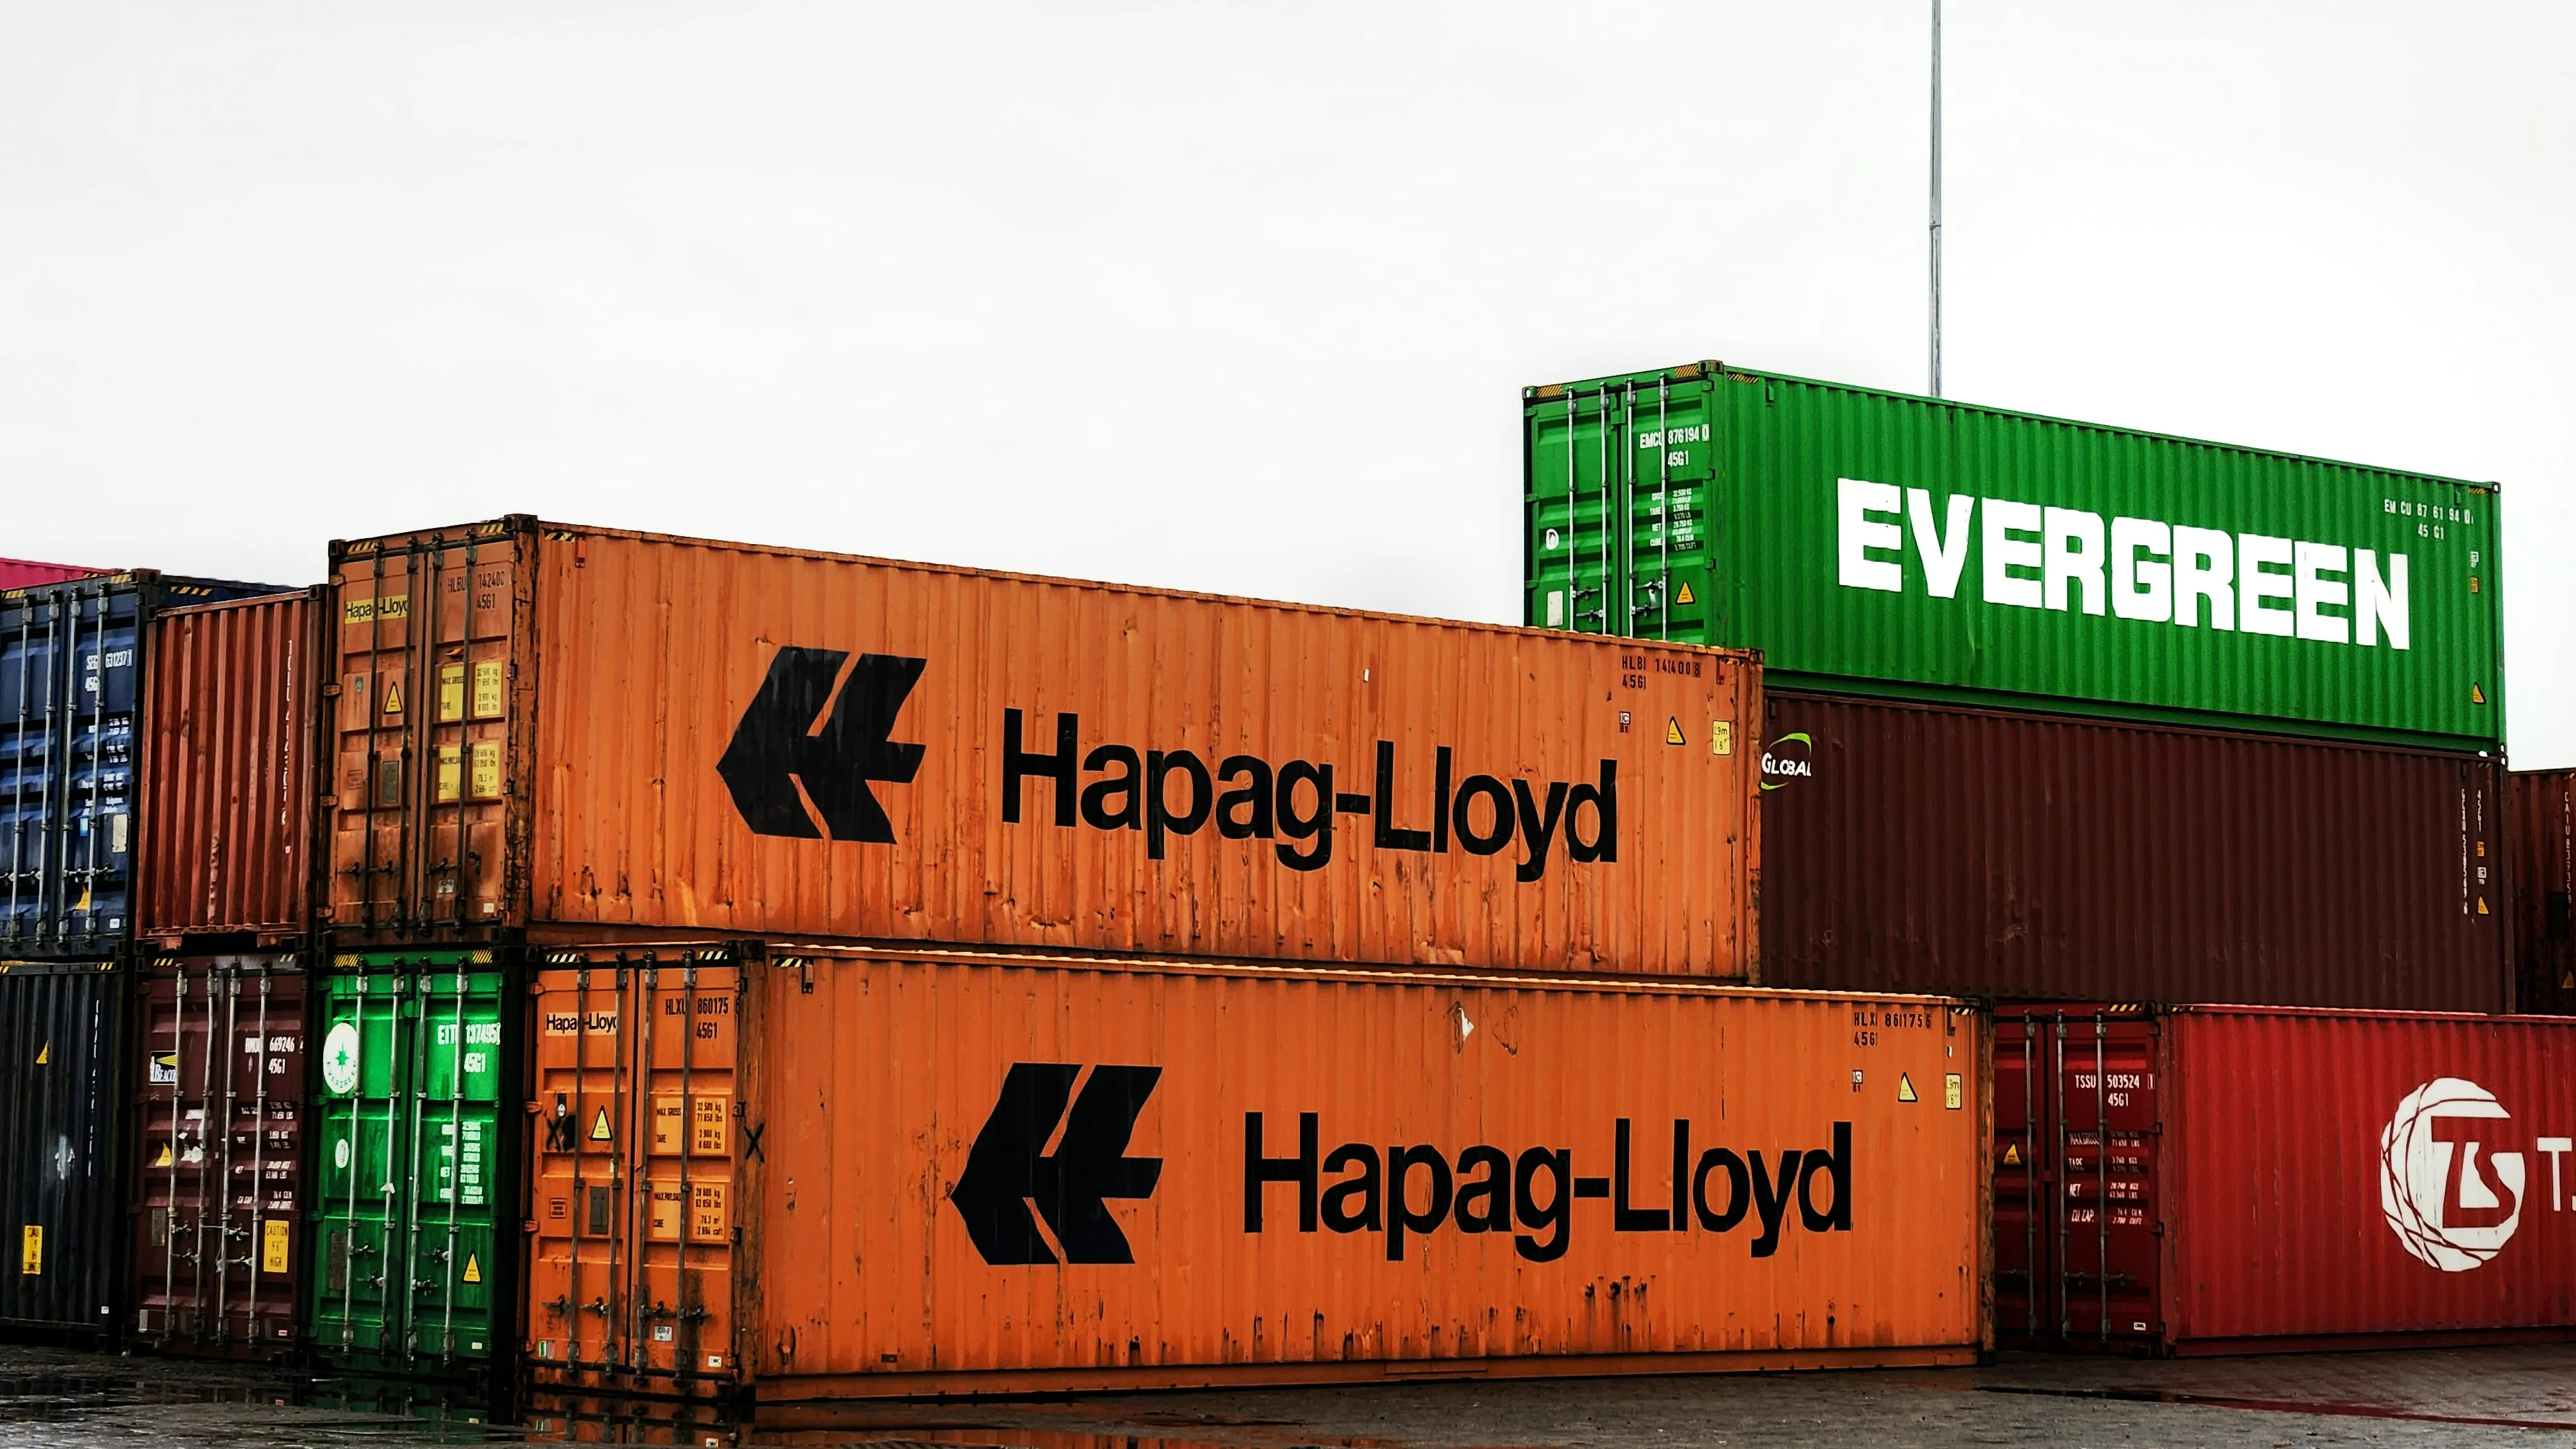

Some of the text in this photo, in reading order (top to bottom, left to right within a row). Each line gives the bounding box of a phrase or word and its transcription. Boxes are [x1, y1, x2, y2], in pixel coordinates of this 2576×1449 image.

[1668, 426, 1699, 444] 876194
[1668, 450, 1689, 467] 45G1
[1651, 492, 1662, 501] GROS
[1838, 478, 2409, 650] EVERGREEN
[479, 571, 505, 589] 142400
[346, 598, 408, 619] Hapa-Lloy
[477, 594, 495, 609] 45G1
[86, 654, 99, 670] SEG
[85, 676, 100, 691] 45G
[1761, 752, 1812, 777] GLOBAL
[1002, 707, 1617, 882] Hapag-Lloyd
[698, 997, 728, 1015] 860175
[546, 1012, 616, 1033] Hapa-Lloy
[696, 1022, 717, 1038] 45G1
[269, 1036, 295, 1052] 669246
[268, 1058, 286, 1074] 45G1
[464, 1052, 486, 1072] 45G1
[155, 1064, 175, 1081] BEACO
[2075, 1075, 2096, 1089] TSSU
[2107, 1074, 2140, 1089] 503524
[2108, 1093, 2128, 1107] 45G1
[668, 1107, 681, 1116] GROSS
[1244, 1112, 1852, 1263] Hapag-Lloyd
[2070, 1183, 2081, 1197] NET
